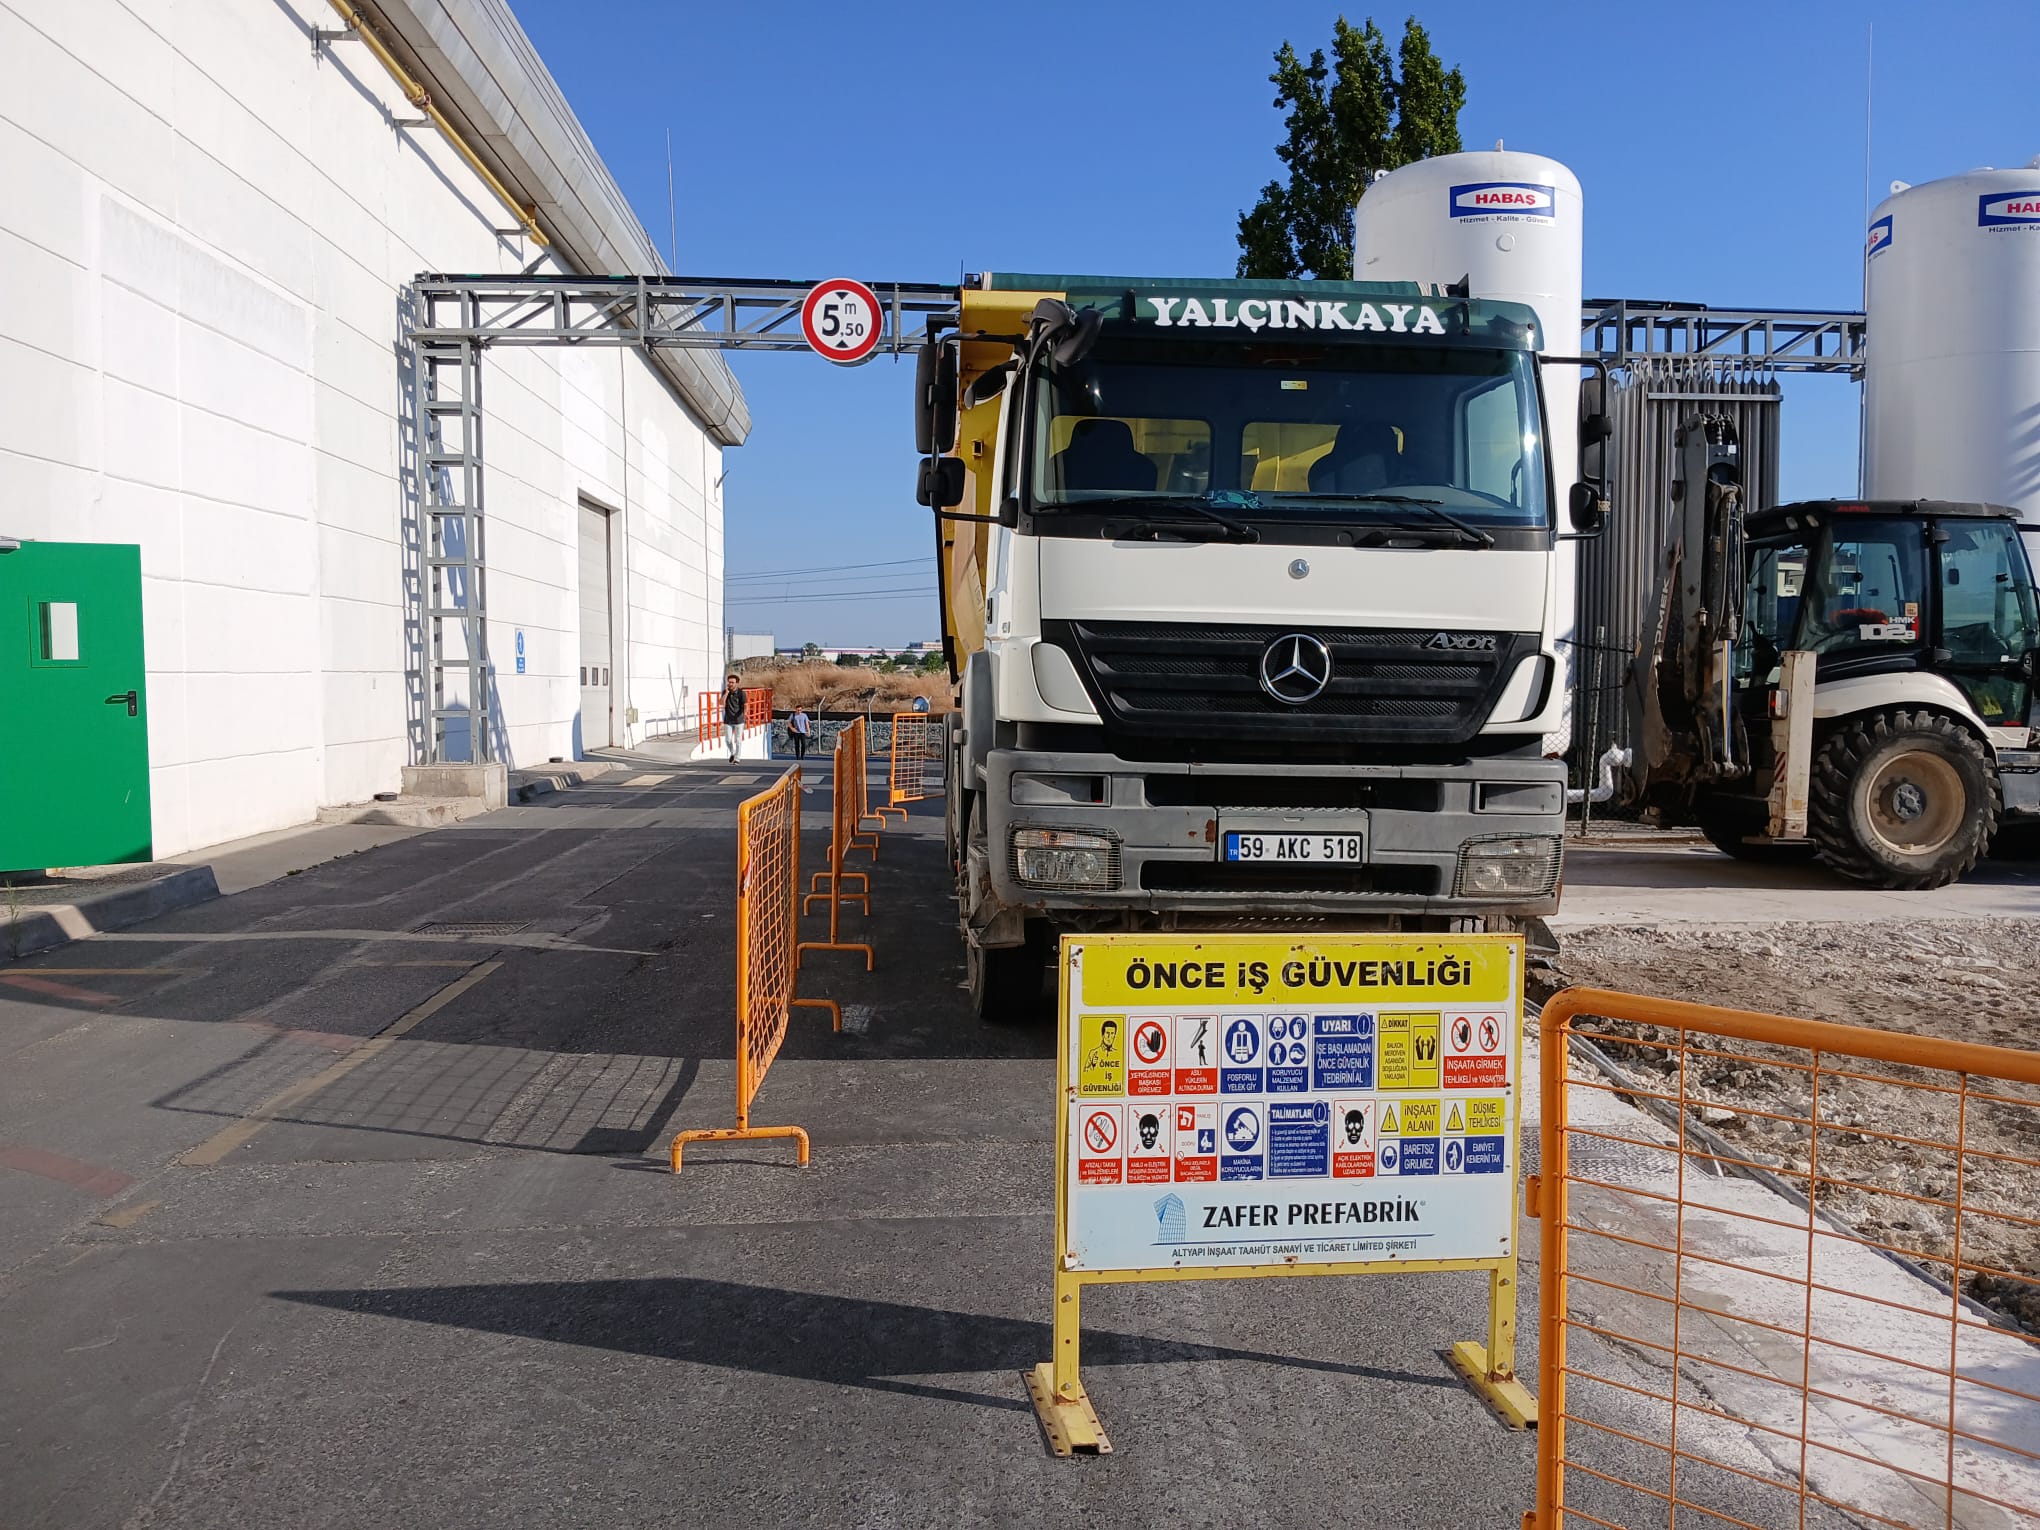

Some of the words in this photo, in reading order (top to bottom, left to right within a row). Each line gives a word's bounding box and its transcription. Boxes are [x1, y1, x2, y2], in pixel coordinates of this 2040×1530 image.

[1475, 193, 1536, 206] HABAŞ
[1459, 216, 1489, 224] Hizmet
[1147, 297, 1446, 335] YALÇINKAYA
[1889, 616, 1916, 624] HMK
[1240, 837, 1264, 858] 59
[1276, 837, 1311, 859] AKC
[1323, 838, 1358, 860] 518
[1125, 957, 1226, 989] ÖNCE
[1321, 1020, 1351, 1032] UYARI
[1327, 1042, 1371, 1057] BAŞLAMADAN
[1099, 1059, 1120, 1068] ÖNCE
[1317, 1056, 1336, 1070] ÖNCE
[1355, 1071, 1363, 1083] AL
[1406, 1120, 1434, 1132] ALANI
[1203, 1204, 1278, 1228] ZAFER
[1287, 1194, 1420, 1226] PREFABRİK
[1172, 1248, 1206, 1258] ALTYAPI
[1207, 1245, 1237, 1258] İNŞAAT
[1273, 1242, 1302, 1254] SANAYİ
[1303, 1242, 1315, 1253] VE
[1316, 1240, 1351, 1252] TİCARET
[1352, 1240, 1384, 1252] LİMİTED
